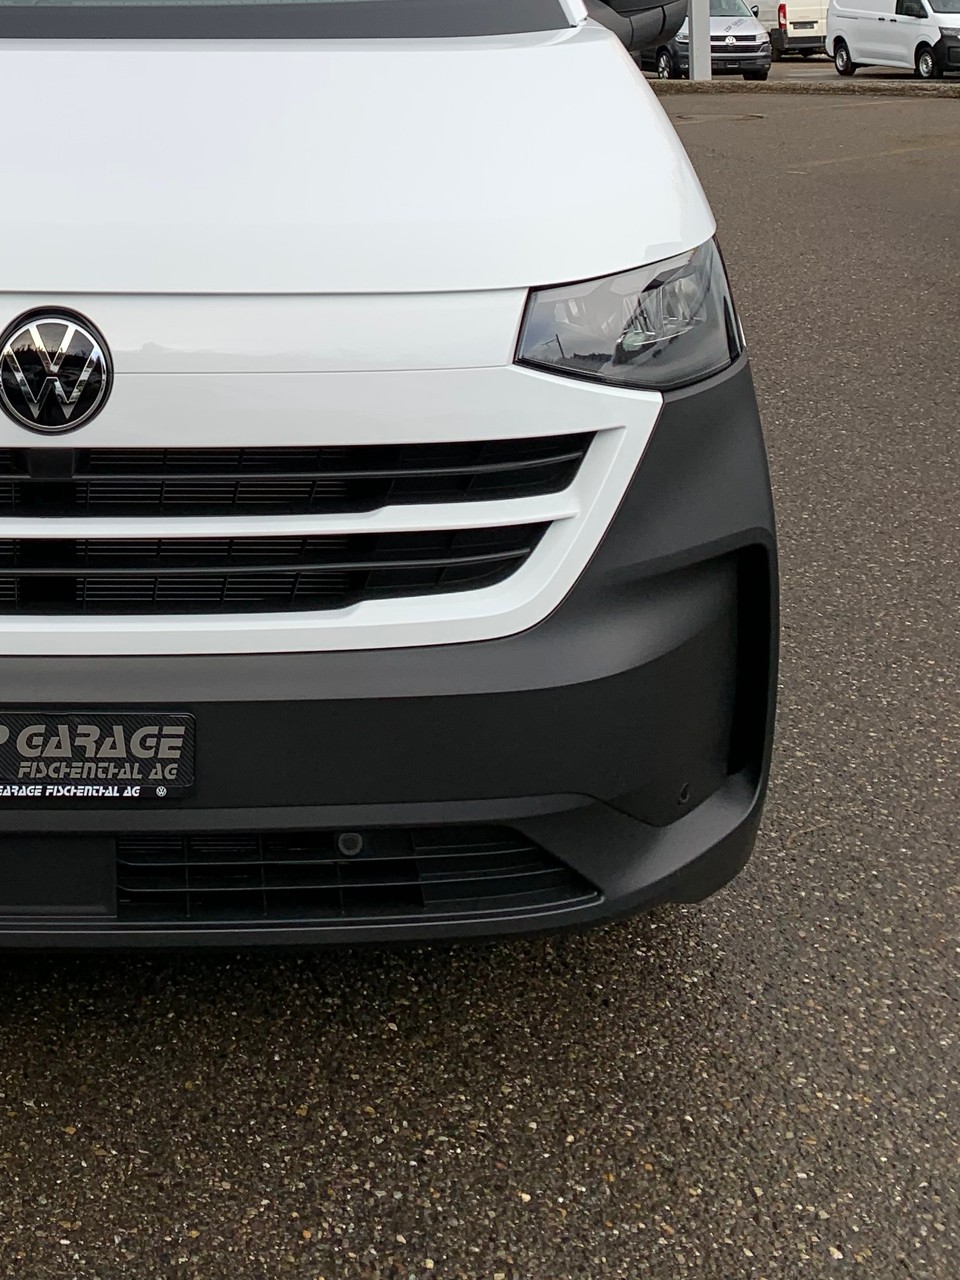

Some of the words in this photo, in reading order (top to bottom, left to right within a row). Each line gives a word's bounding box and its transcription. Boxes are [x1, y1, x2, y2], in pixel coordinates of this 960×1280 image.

[16, 724, 186, 759] GARAGE
[17, 761, 143, 780] FISCHENTHAL
[148, 763, 178, 780] AG
[45, 785, 119, 797] FISCHENTHAL
[123, 785, 140, 797] AG
